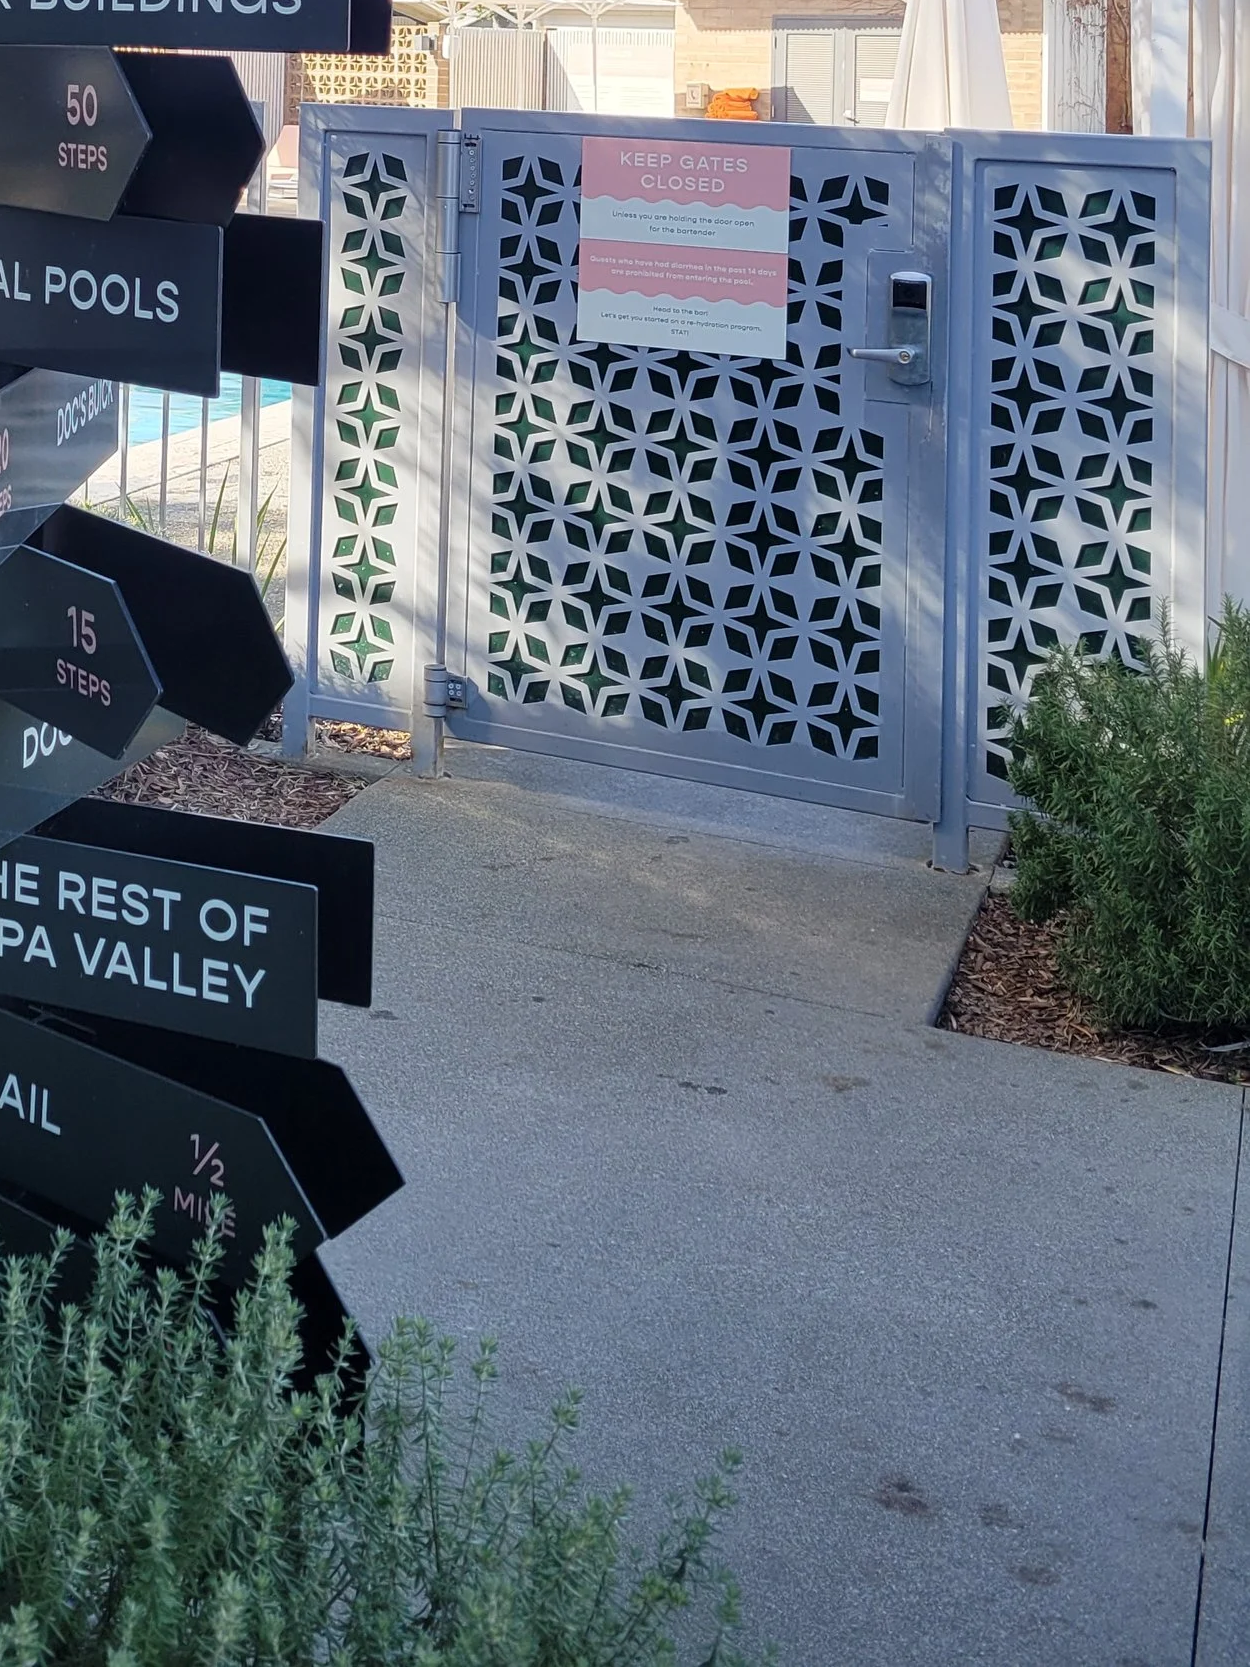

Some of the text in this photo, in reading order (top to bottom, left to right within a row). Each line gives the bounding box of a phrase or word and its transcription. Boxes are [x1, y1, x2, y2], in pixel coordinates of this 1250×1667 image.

[66, 84, 98, 126] 50
[58, 143, 107, 172] STEPS
[620, 151, 748, 172] KEEP GATES
[641, 174, 725, 192] CLOSED
[612, 210, 637, 219] Unless
[669, 214, 697, 224] holding
[677, 227, 716, 236] bartender
[654, 260, 669, 268] had
[728, 267, 747, 275] past
[758, 268, 777, 277] days
[685, 273, 717, 283] entering
[45, 265, 179, 323] POOLS
[644, 315, 668, 324] started
[57, 379, 114, 447] DOC'S BUICK
[67, 606, 96, 654] 15
[56, 659, 111, 706] STEPS
[59, 871, 180, 932] REST
[198, 899, 269, 947] OF
[73, 932, 266, 1009] VALLEY
[190, 1134, 225, 1187] 1/2
